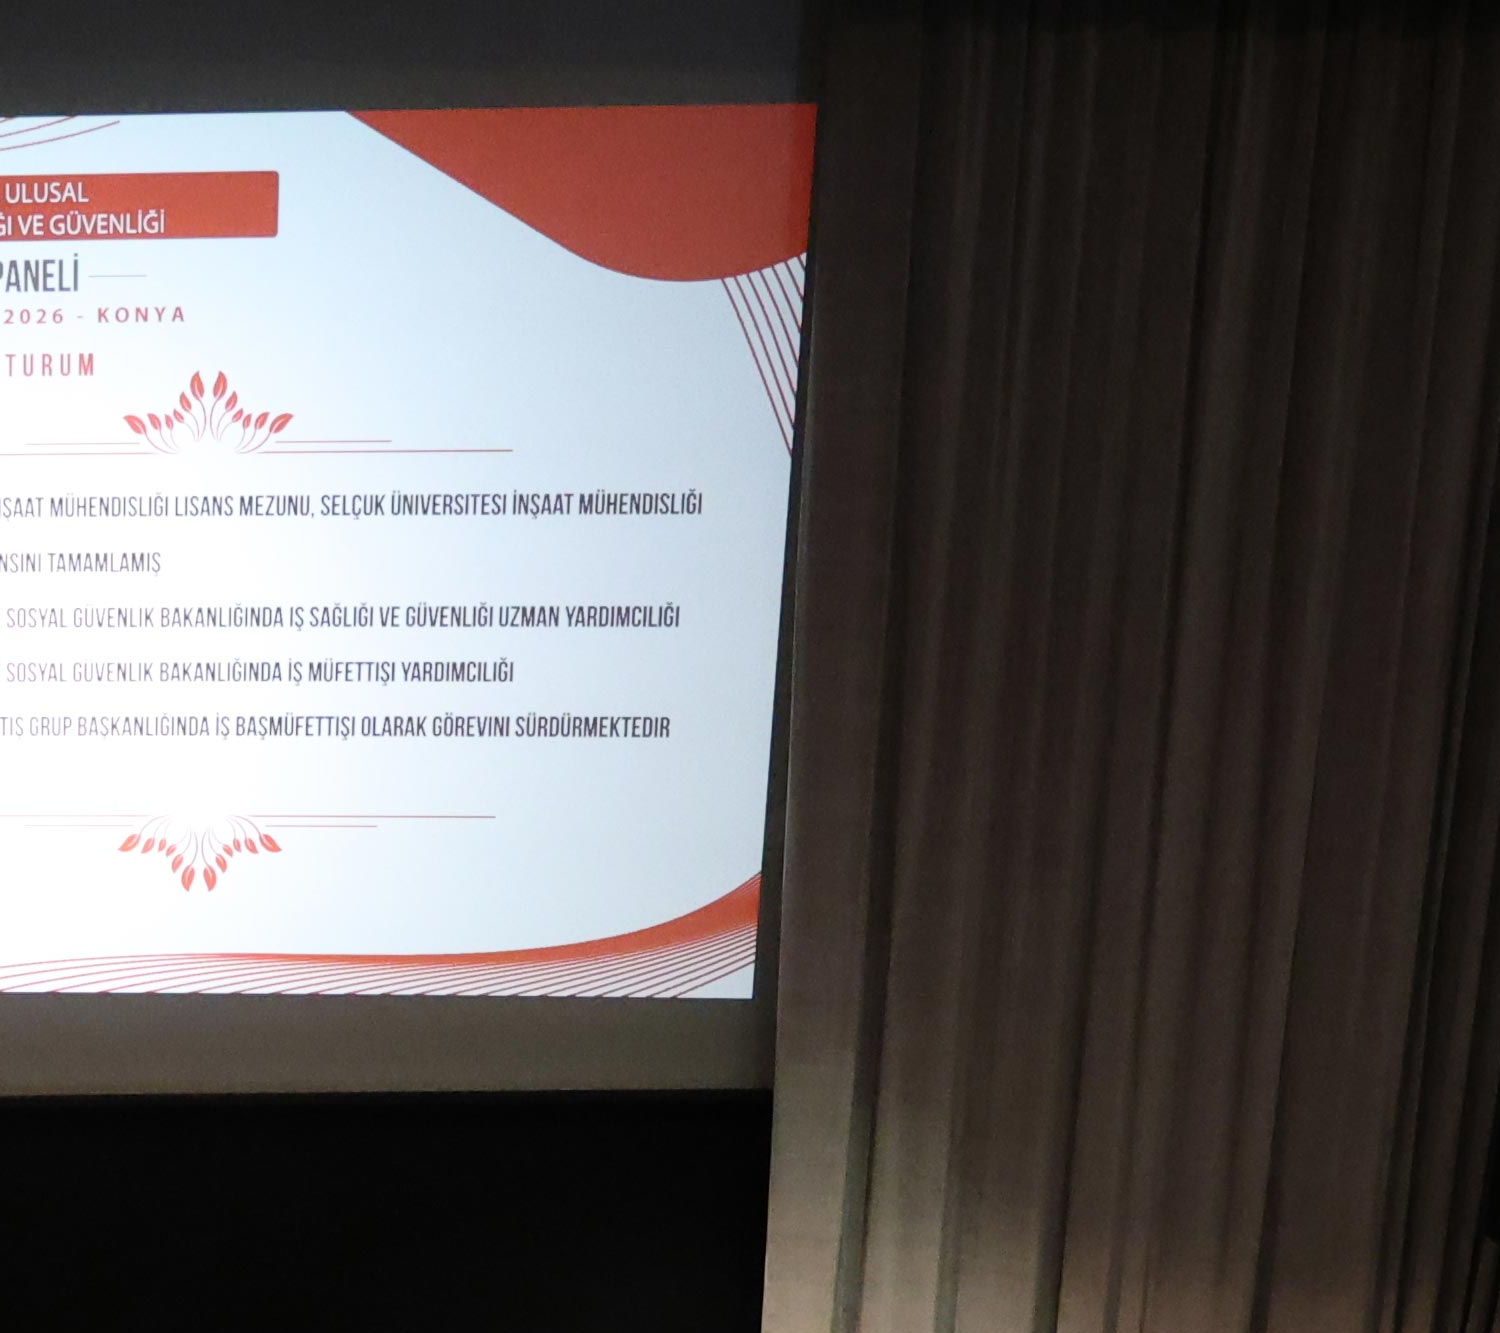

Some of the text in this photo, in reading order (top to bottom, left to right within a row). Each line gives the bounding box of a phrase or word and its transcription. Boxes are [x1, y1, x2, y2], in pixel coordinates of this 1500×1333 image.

[6, 182, 89, 203] ULUSAL
[18, 214, 44, 236] VE
[49, 210, 165, 235] GÜVENLİĞİ
[4, 308, 63, 324] 2026
[98, 306, 184, 323] KONYA
[240, 494, 314, 518] MEZUNU,
[321, 494, 385, 520] SELÇUK
[513, 489, 574, 519] İNŞAAT
[48, 552, 160, 576] TAMAMLAMIŞ
[7, 608, 67, 628] SOSYAL
[161, 603, 283, 628] BAKANLIĞINDA
[310, 602, 373, 628] SAĞLIĞI
[380, 606, 400, 628] VE
[499, 605, 559, 627] UZMAN
[565, 601, 680, 628] YARDIMCILIĞI
[7, 662, 66, 683] SOSYAL
[160, 658, 282, 682] BAKANLIĞINDA
[288, 658, 302, 686] İŞ
[401, 657, 514, 683] YARDIMCILIĞI
[30, 716, 72, 736] GRUP
[78, 713, 209, 737] BAŞKANLIĞINDA
[216, 712, 230, 740] İŞ
[361, 716, 427, 737] OLARAK
